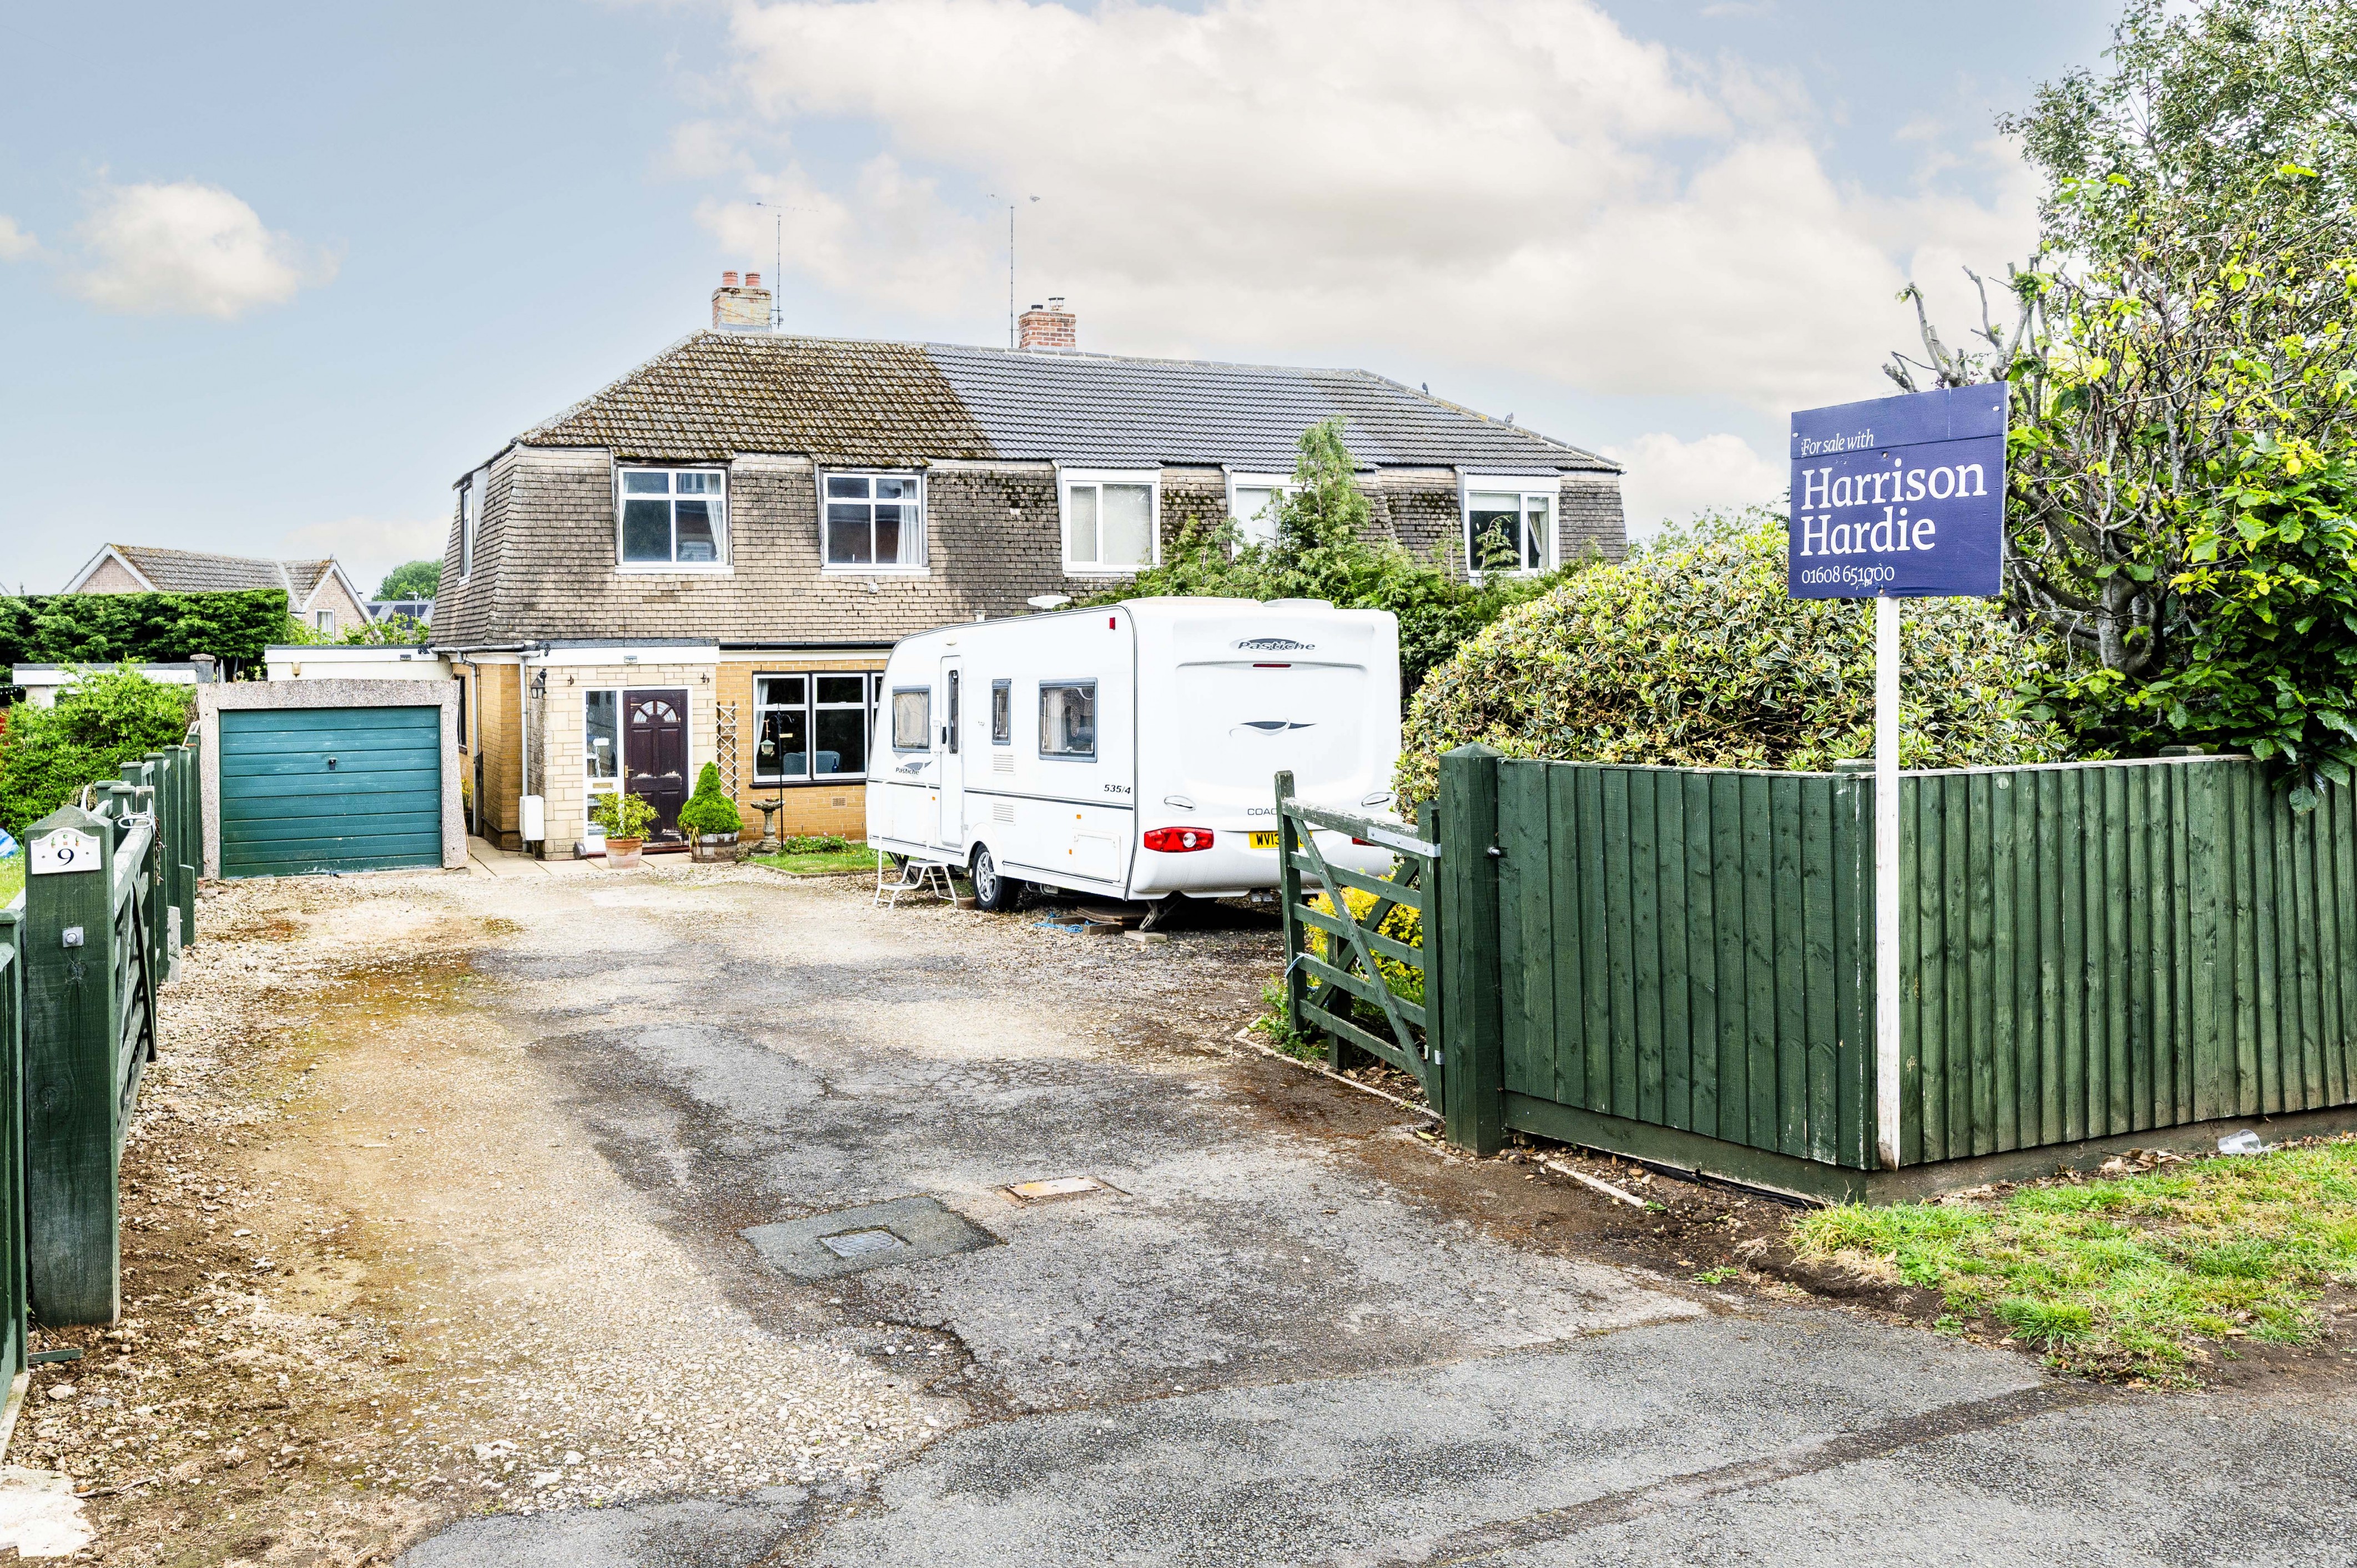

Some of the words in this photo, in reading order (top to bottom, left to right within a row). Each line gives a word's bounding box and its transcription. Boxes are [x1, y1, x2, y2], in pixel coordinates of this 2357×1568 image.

[1802, 438, 1822, 456] For
[1822, 433, 1845, 453] sale
[1847, 428, 1874, 450] with
[1801, 458, 1987, 510] Harrison
[1800, 506, 1936, 556] Hardie
[1802, 566, 1840, 583] 01608
[1842, 565, 1895, 586] 651000
[1238, 641, 1316, 651] Pastiche
[1104, 784, 1131, 794] 535/4
[57, 848, 74, 866] 9
